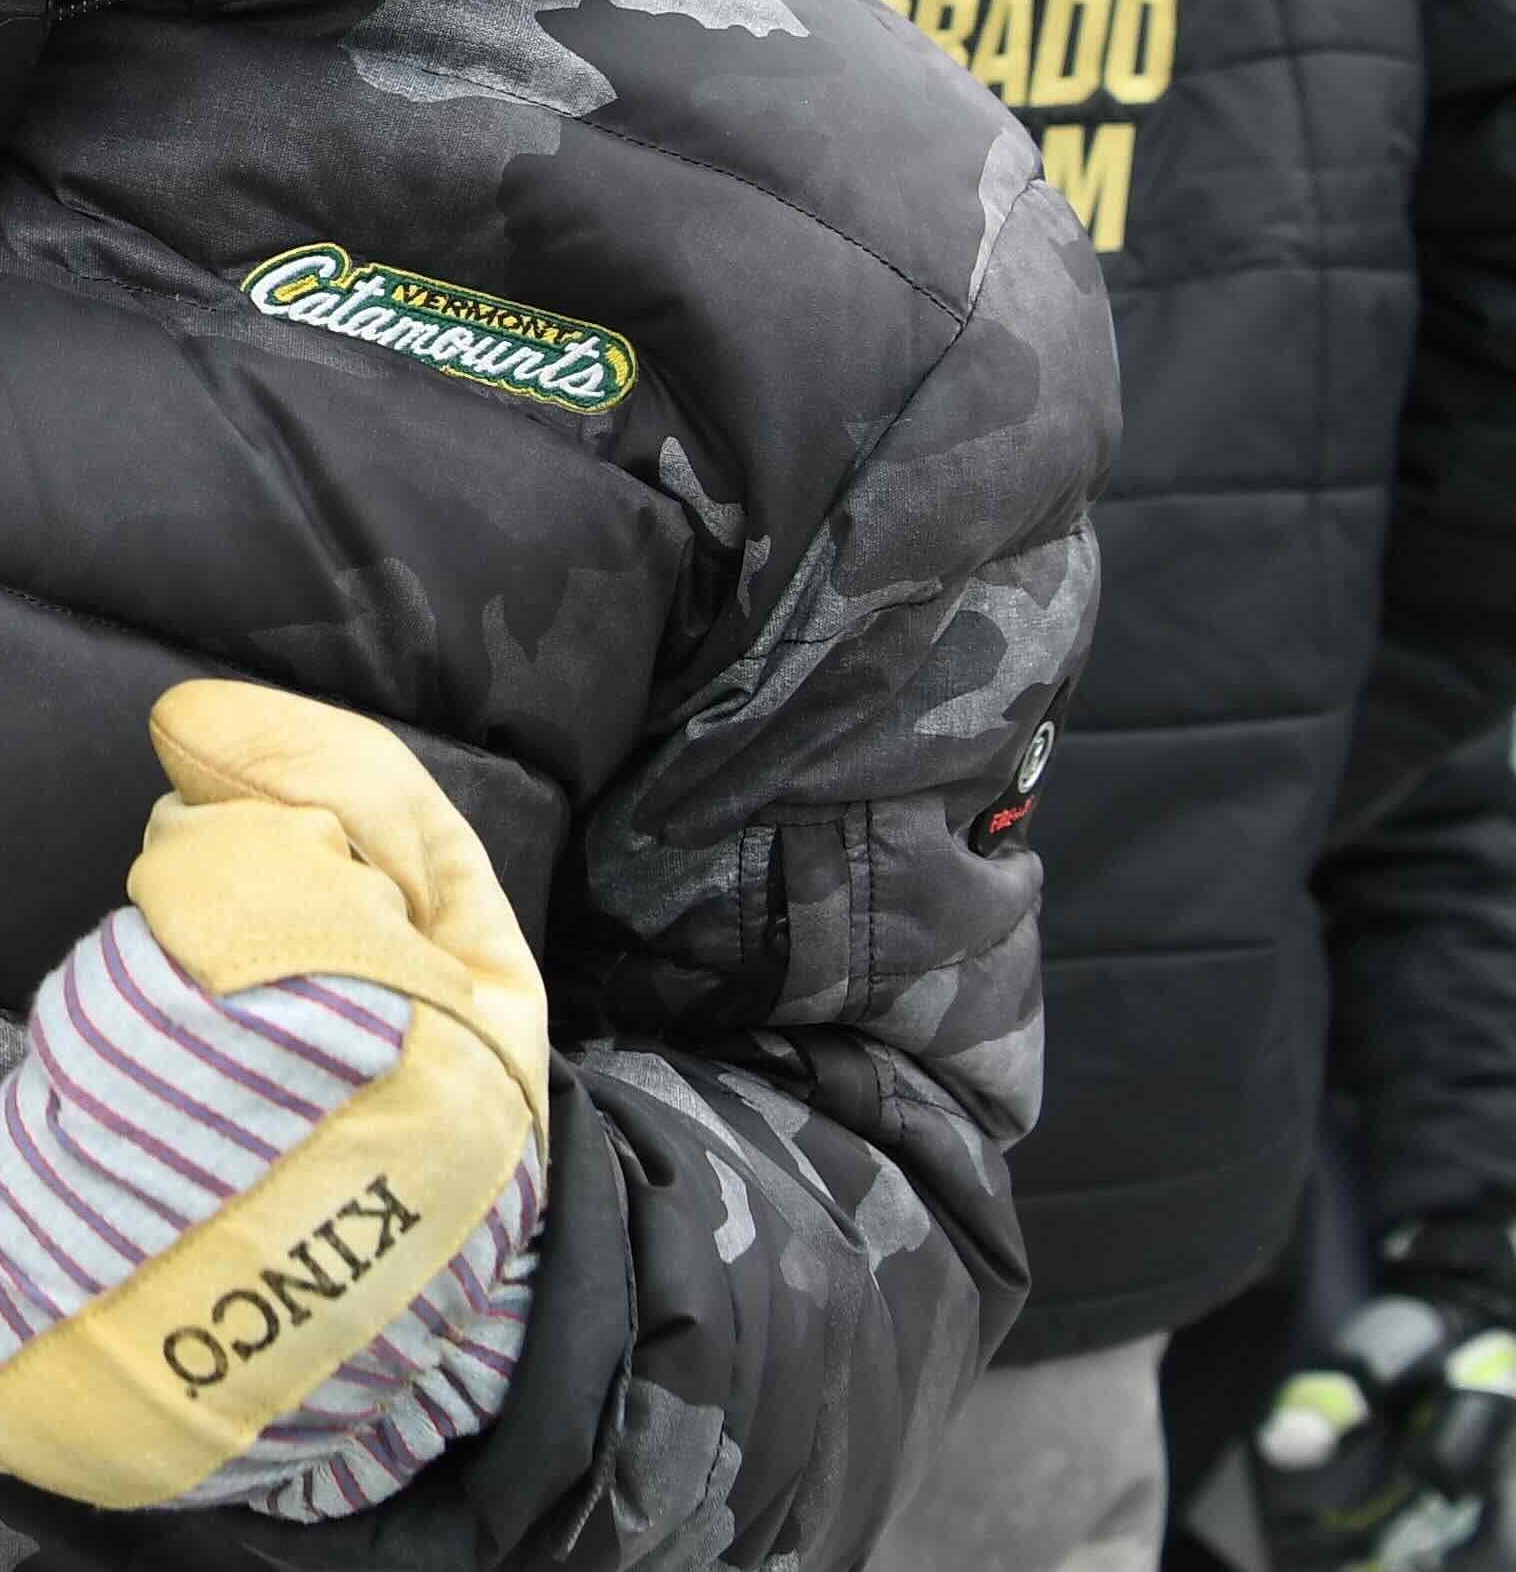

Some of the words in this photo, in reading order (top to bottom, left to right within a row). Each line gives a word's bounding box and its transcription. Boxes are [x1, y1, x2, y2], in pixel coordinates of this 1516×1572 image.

[250, 254, 605, 399] Catamounts
[392, 282, 582, 345] VERMONT
[163, 1173, 421, 1390] KINCO
